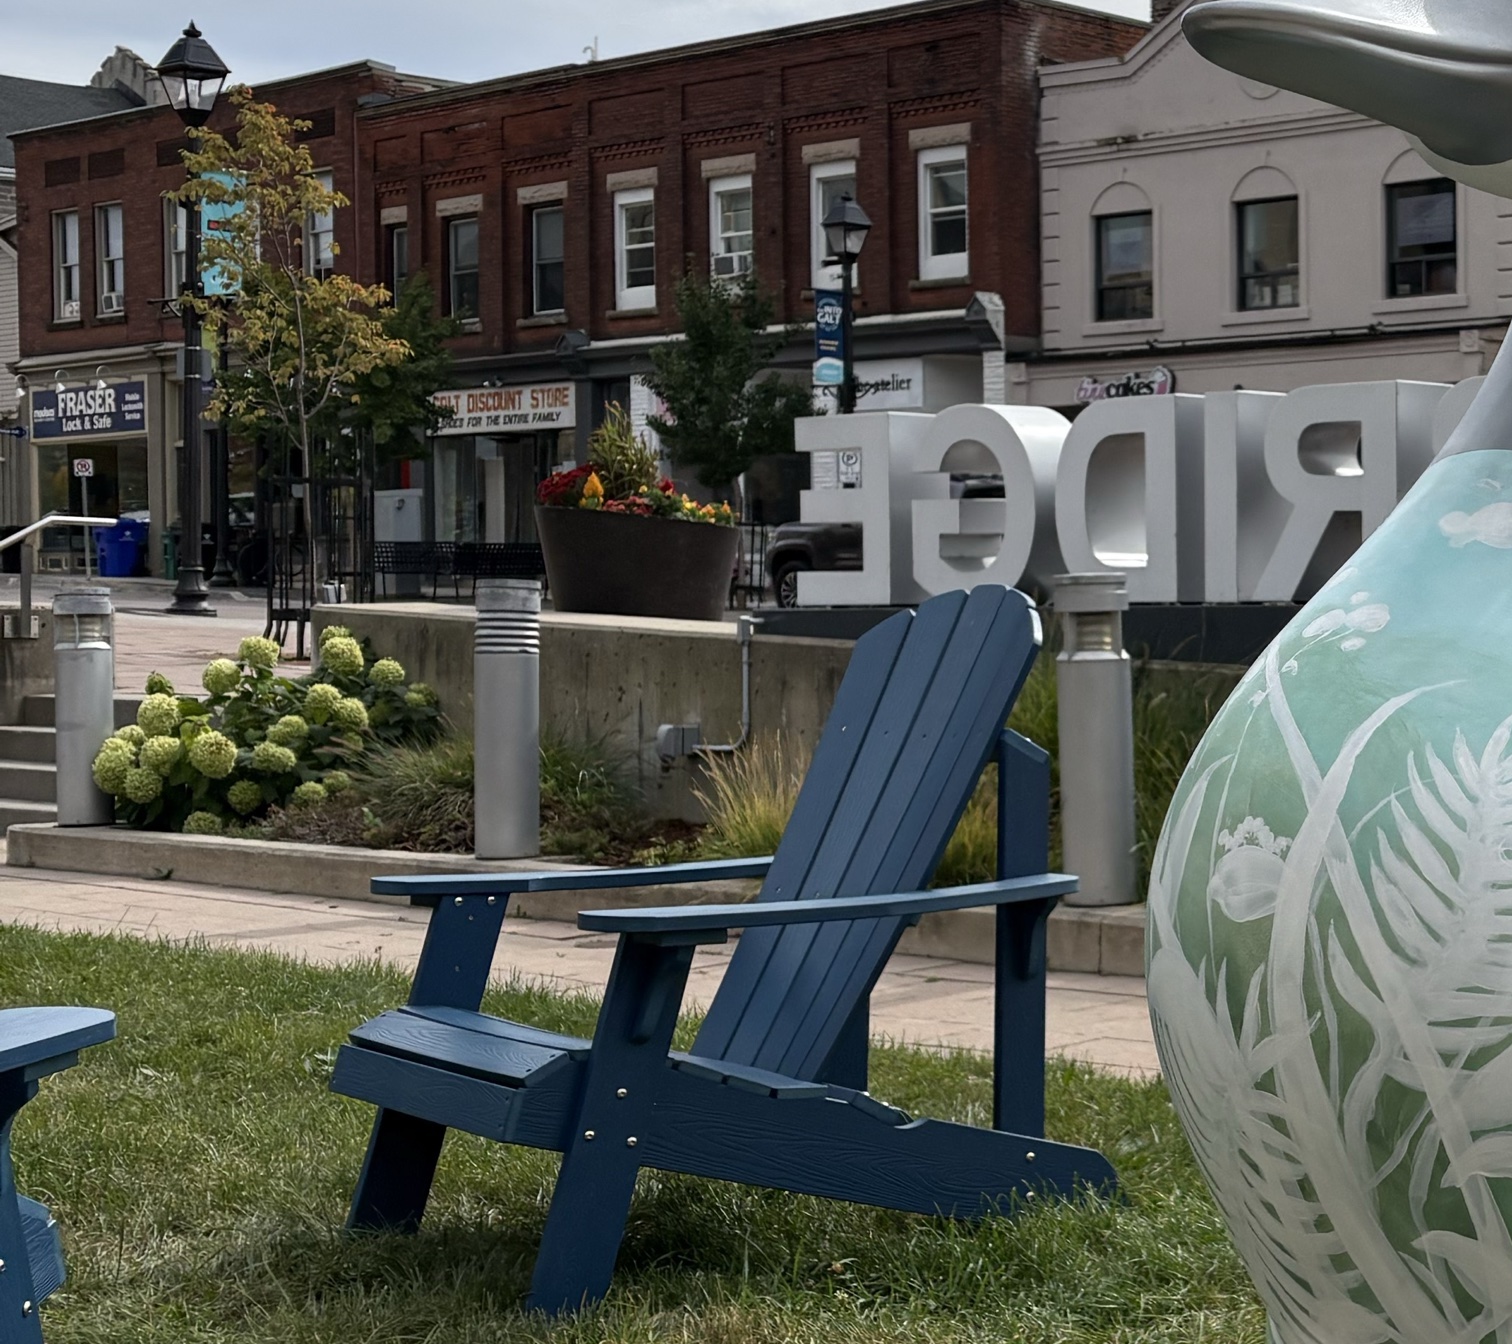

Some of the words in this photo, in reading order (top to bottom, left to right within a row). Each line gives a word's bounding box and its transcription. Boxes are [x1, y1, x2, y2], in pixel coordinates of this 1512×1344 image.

[57, 389, 116, 417] FRASER
[466, 389, 524, 414] DISCOUNT
[530, 386, 570, 409] STORE
[62, 417, 82, 432] Lock
[84, 415, 91, 430] &
[93, 414, 112, 430] Safe
[467, 416, 482, 428] FOR
[486, 414, 501, 426] THE
[503, 412, 530, 425] ENTIRE
[532, 411, 562, 424] FAMILY
